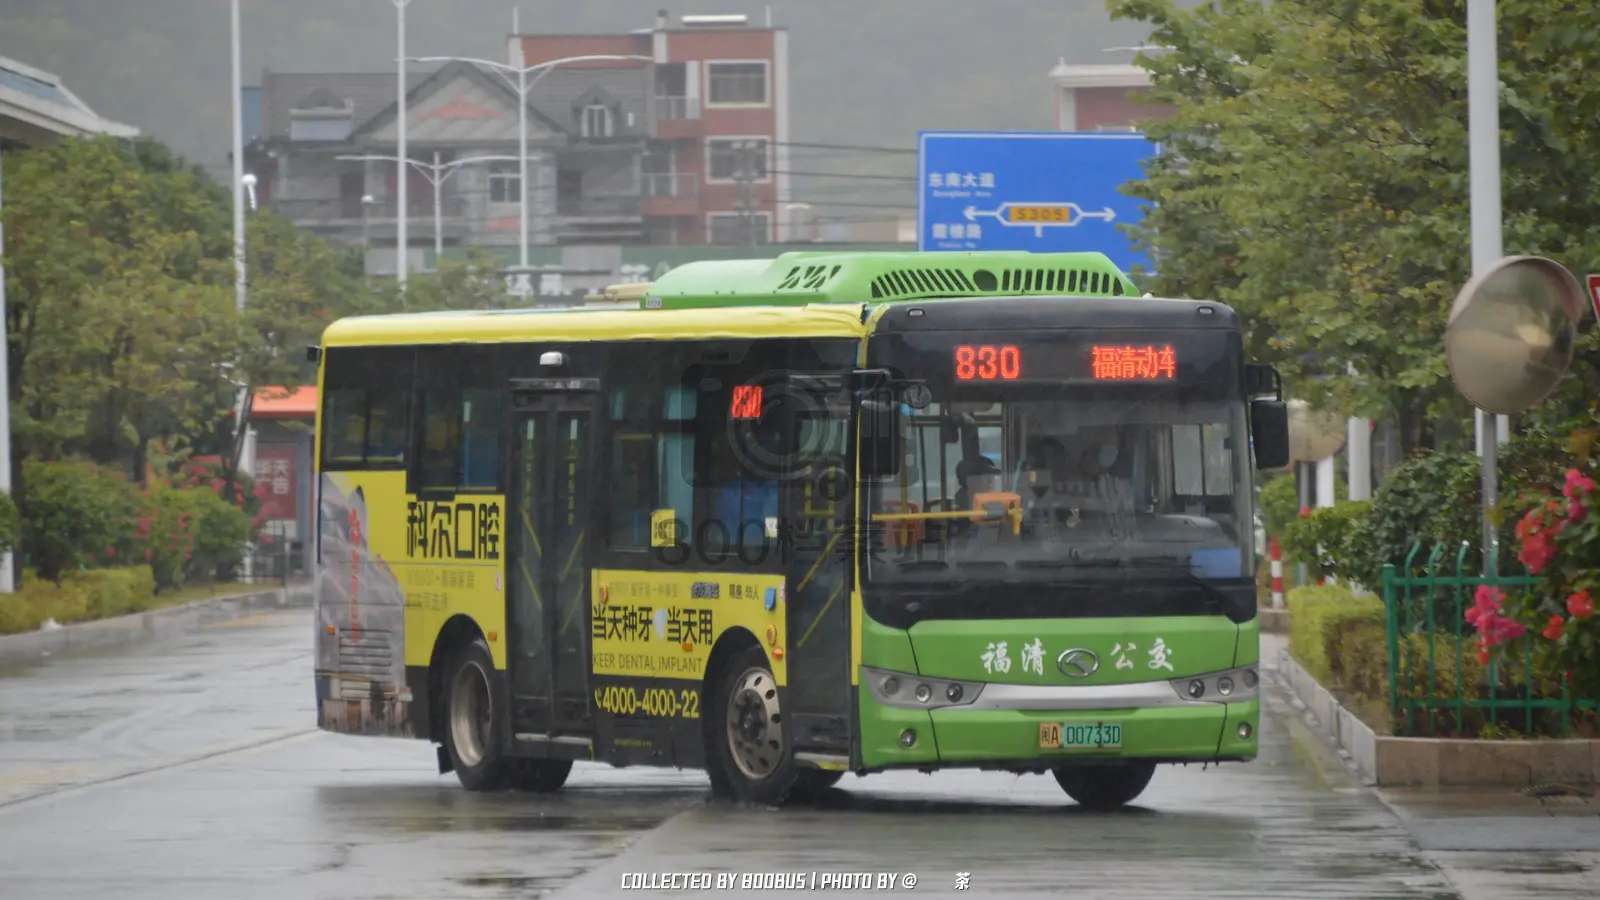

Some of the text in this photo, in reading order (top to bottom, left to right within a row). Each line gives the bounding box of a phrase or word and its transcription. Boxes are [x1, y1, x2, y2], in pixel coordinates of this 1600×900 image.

[956, 345, 1020, 380] 830
[1091, 344, 1176, 379] 福清动车
[731, 385, 763, 418] 830
[407, 500, 500, 560] 科尔口腔
[593, 605, 713, 646] 当天种牙 当天用
[593, 653, 703, 674] KEER DENTAL IMPLANT
[980, 637, 1174, 676] 福清 公交
[602, 686, 700, 719] 4000-4000-22
[1041, 724, 1121, 745] 闽A 00733D
